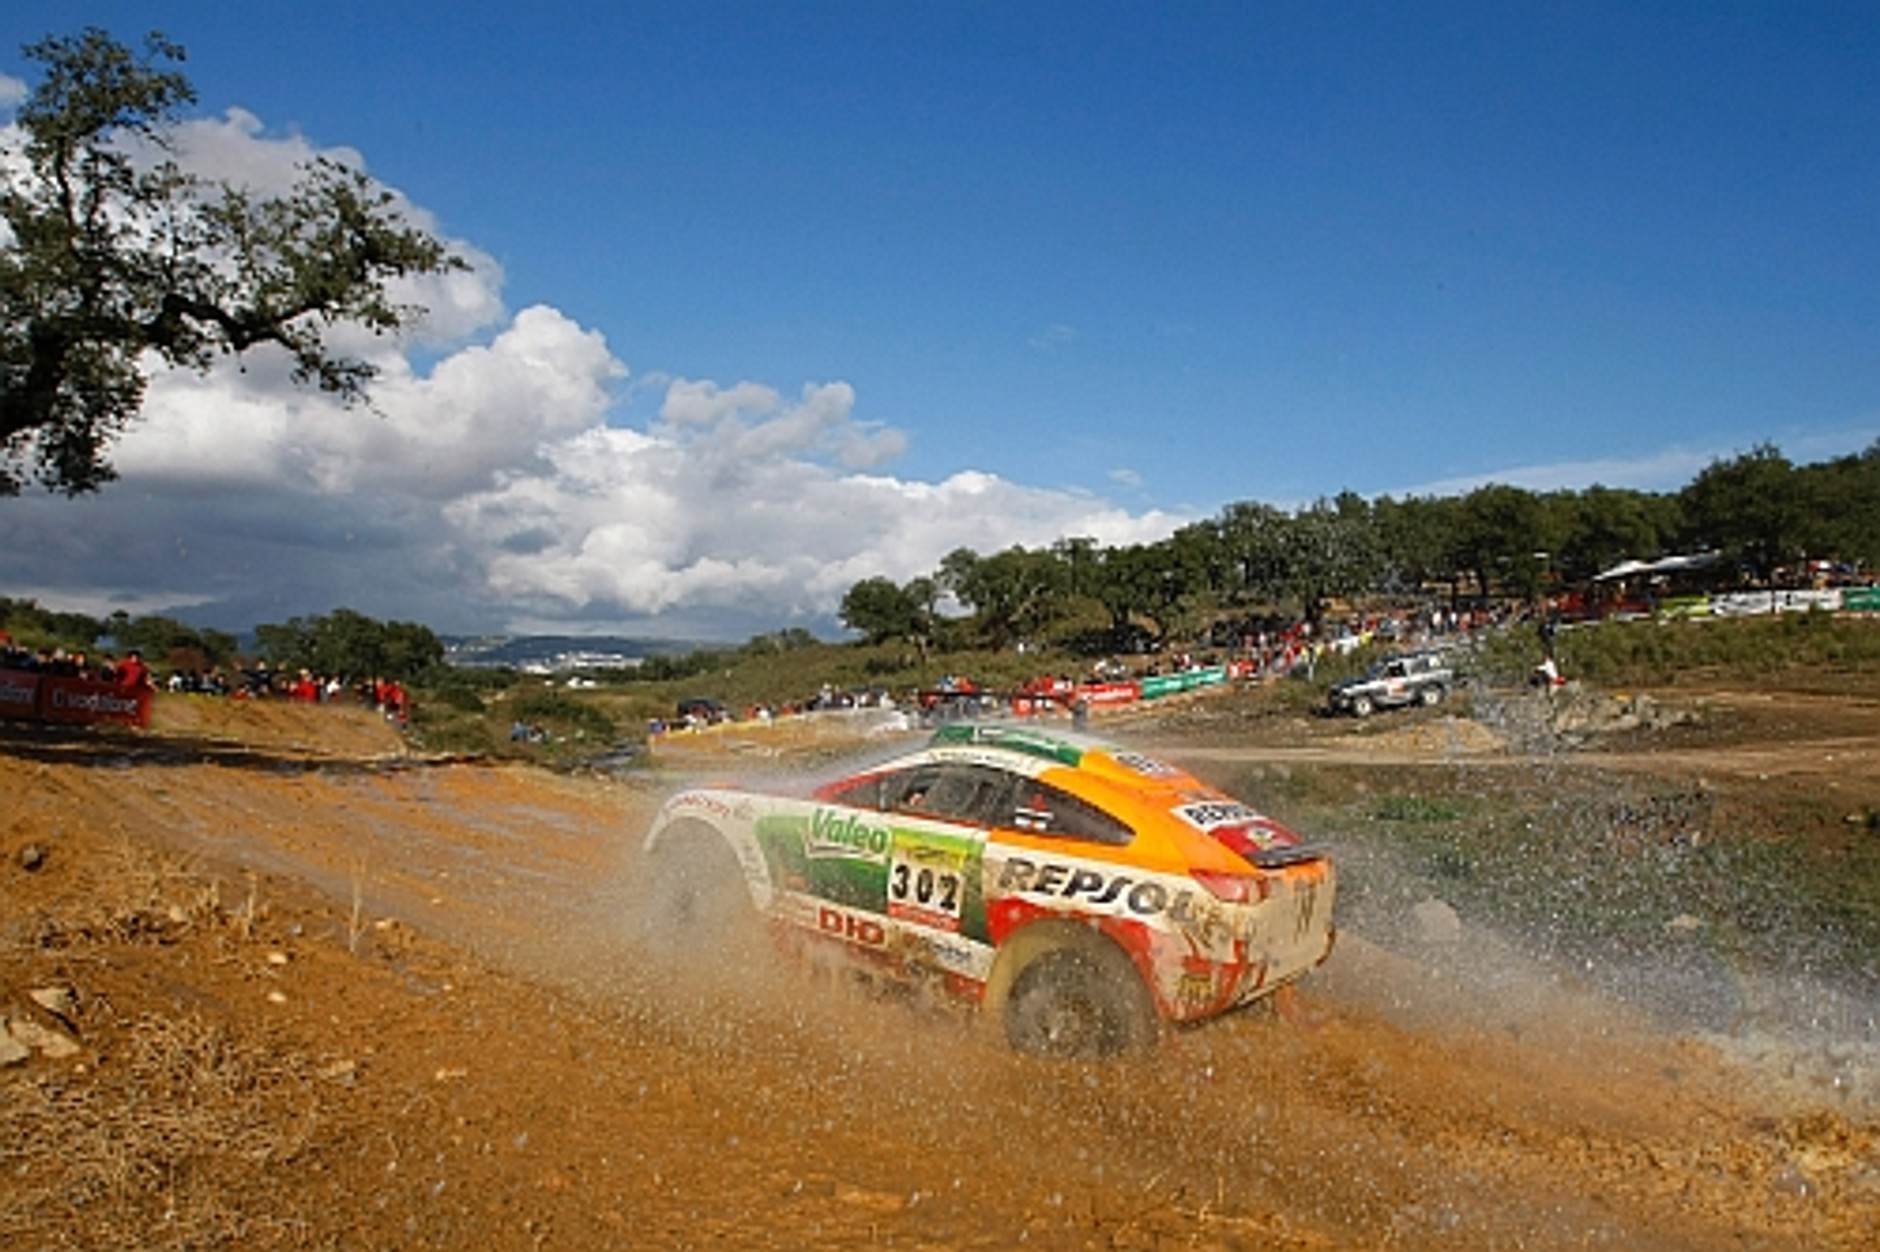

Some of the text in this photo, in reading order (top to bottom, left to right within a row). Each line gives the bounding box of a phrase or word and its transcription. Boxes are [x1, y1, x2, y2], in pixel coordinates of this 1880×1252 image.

[811, 808, 889, 854] Valeo
[891, 864, 960, 911] 302
[999, 857, 1195, 922] REPSOL
